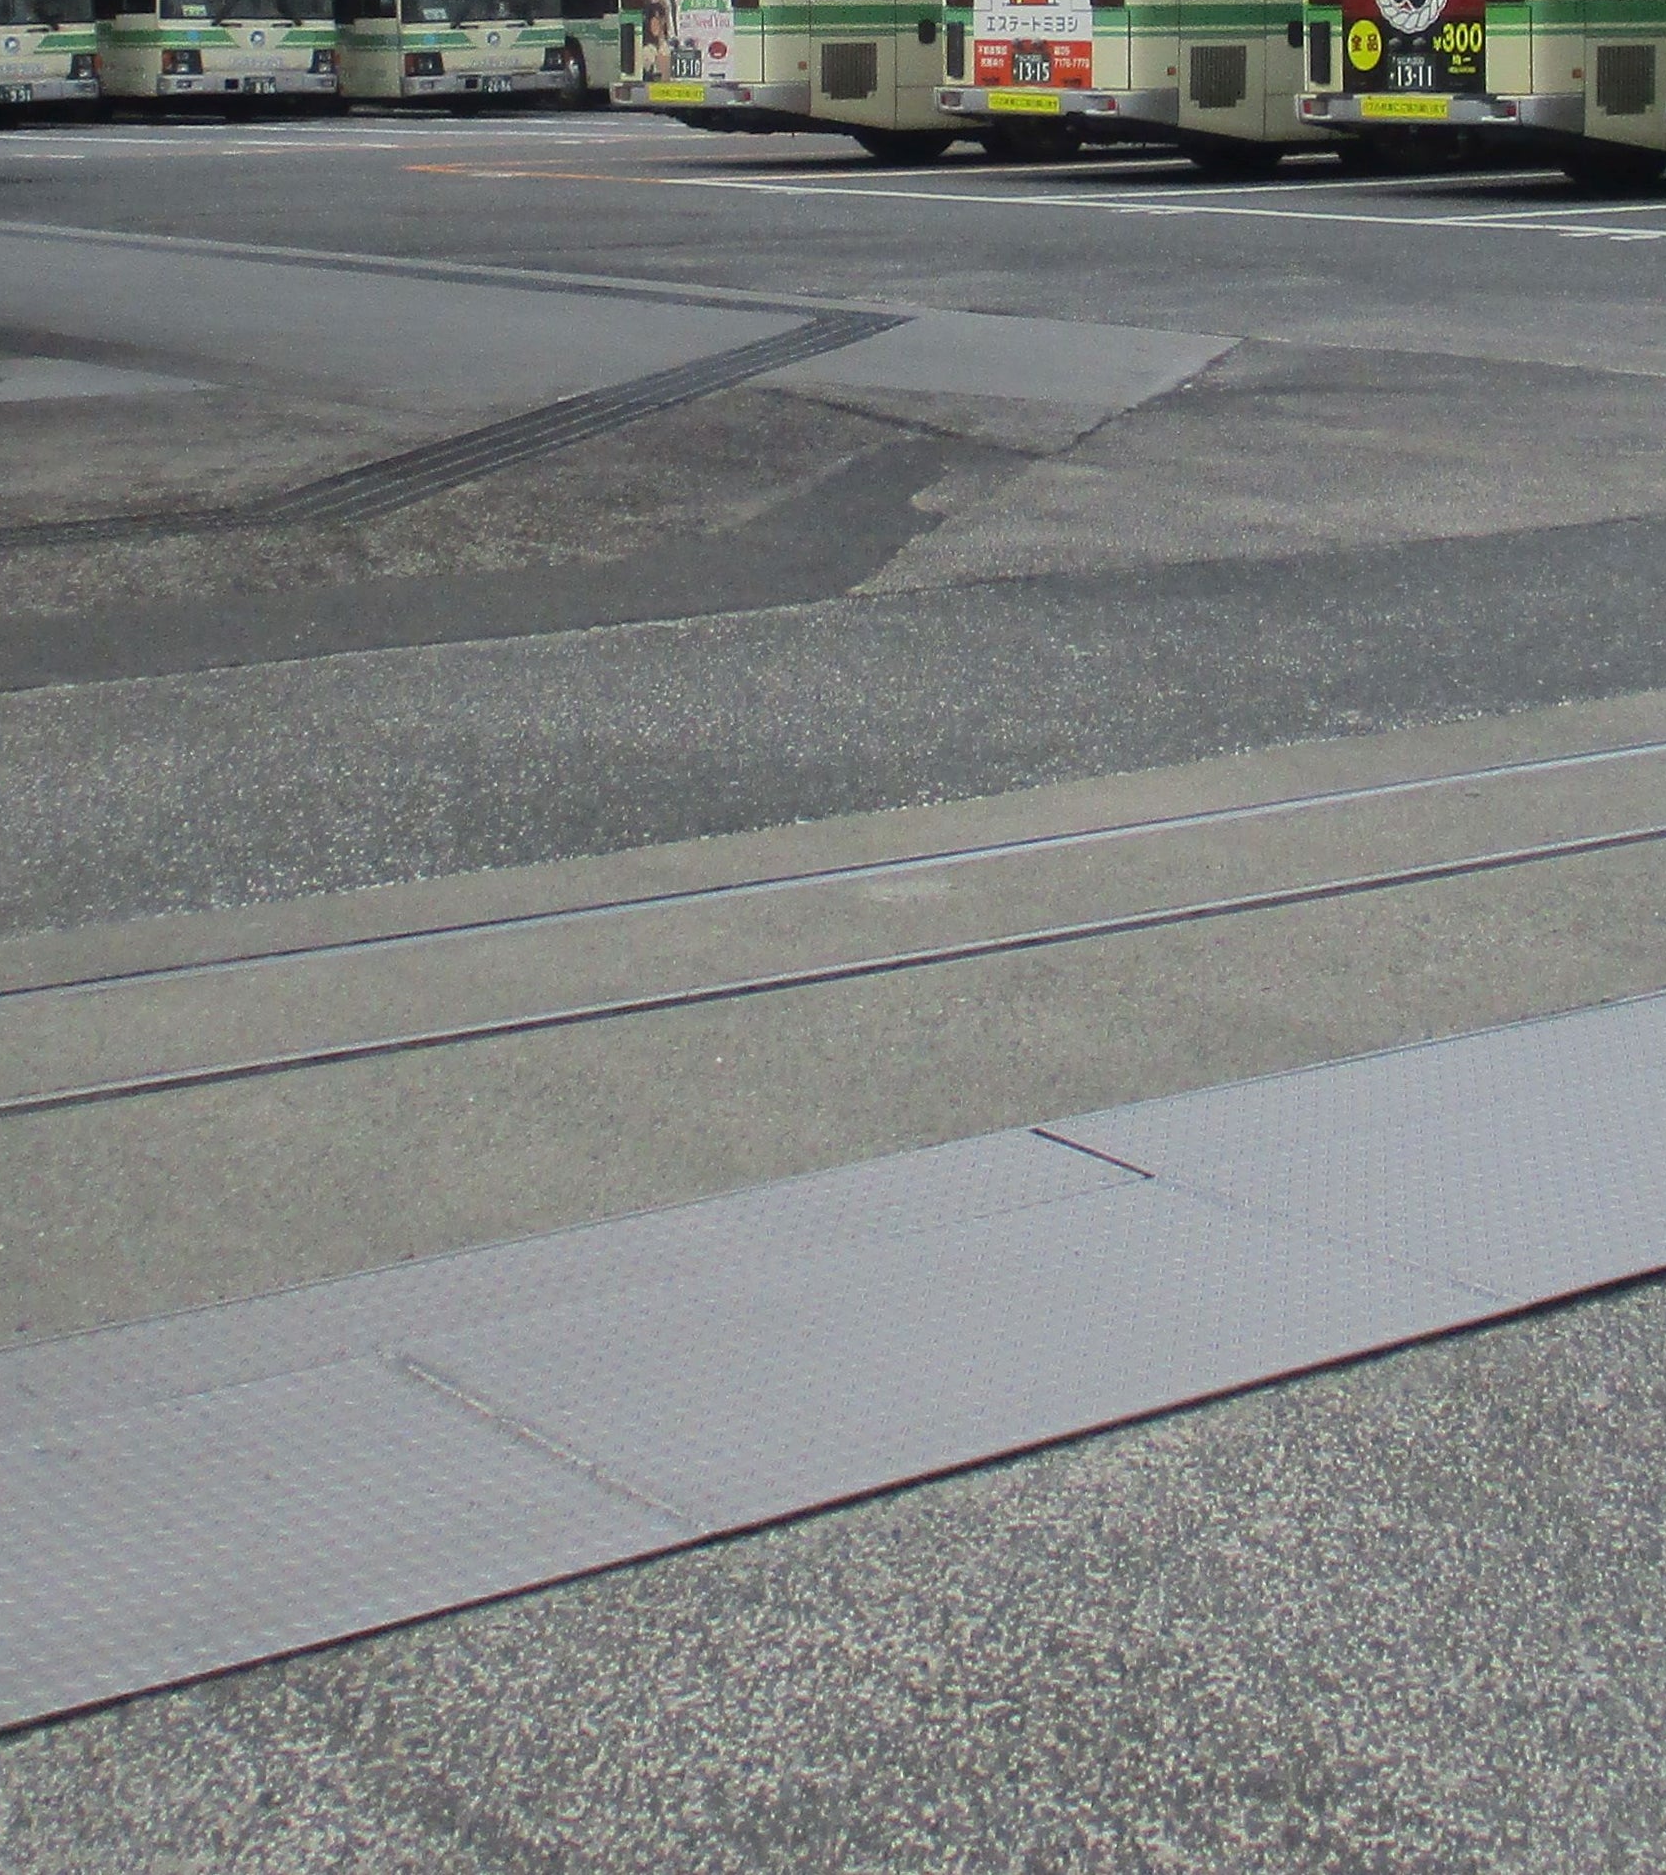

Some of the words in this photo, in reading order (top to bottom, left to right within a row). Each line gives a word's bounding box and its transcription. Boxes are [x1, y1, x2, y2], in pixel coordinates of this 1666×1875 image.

[987, 15, 1079, 33] エステートミヨシ
